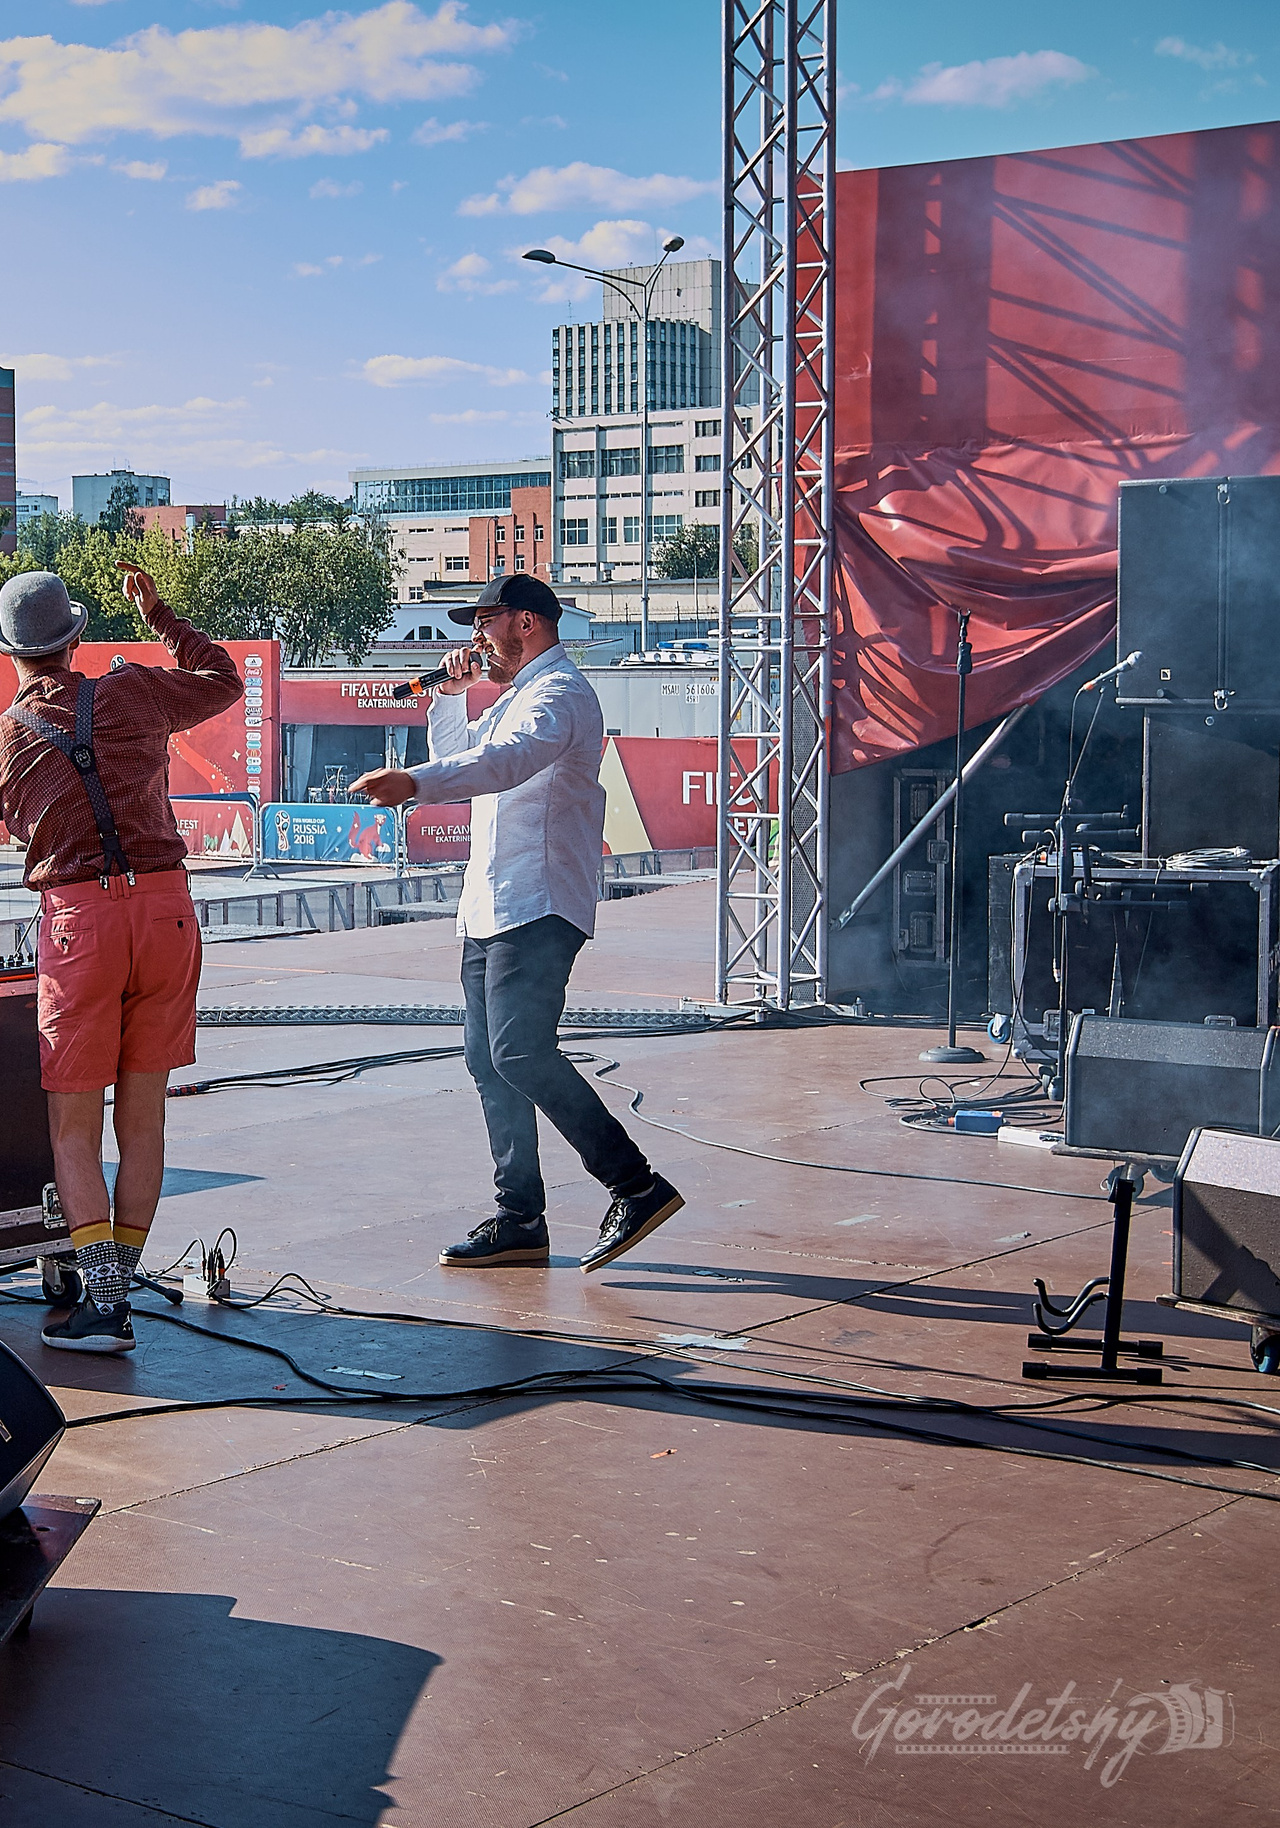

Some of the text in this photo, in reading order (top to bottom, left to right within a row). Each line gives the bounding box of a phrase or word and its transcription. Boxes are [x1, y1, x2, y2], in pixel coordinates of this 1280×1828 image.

[341, 683, 369, 697] FIFA
[662, 684, 715, 695] MSAU 561606
[357, 698, 418, 709] EKATERINBURG
[179, 819, 199, 830] FEST
[293, 824, 327, 834] RUSSIA
[421, 825, 470, 836] FIFA FAN
[293, 834, 315, 845] 2018
